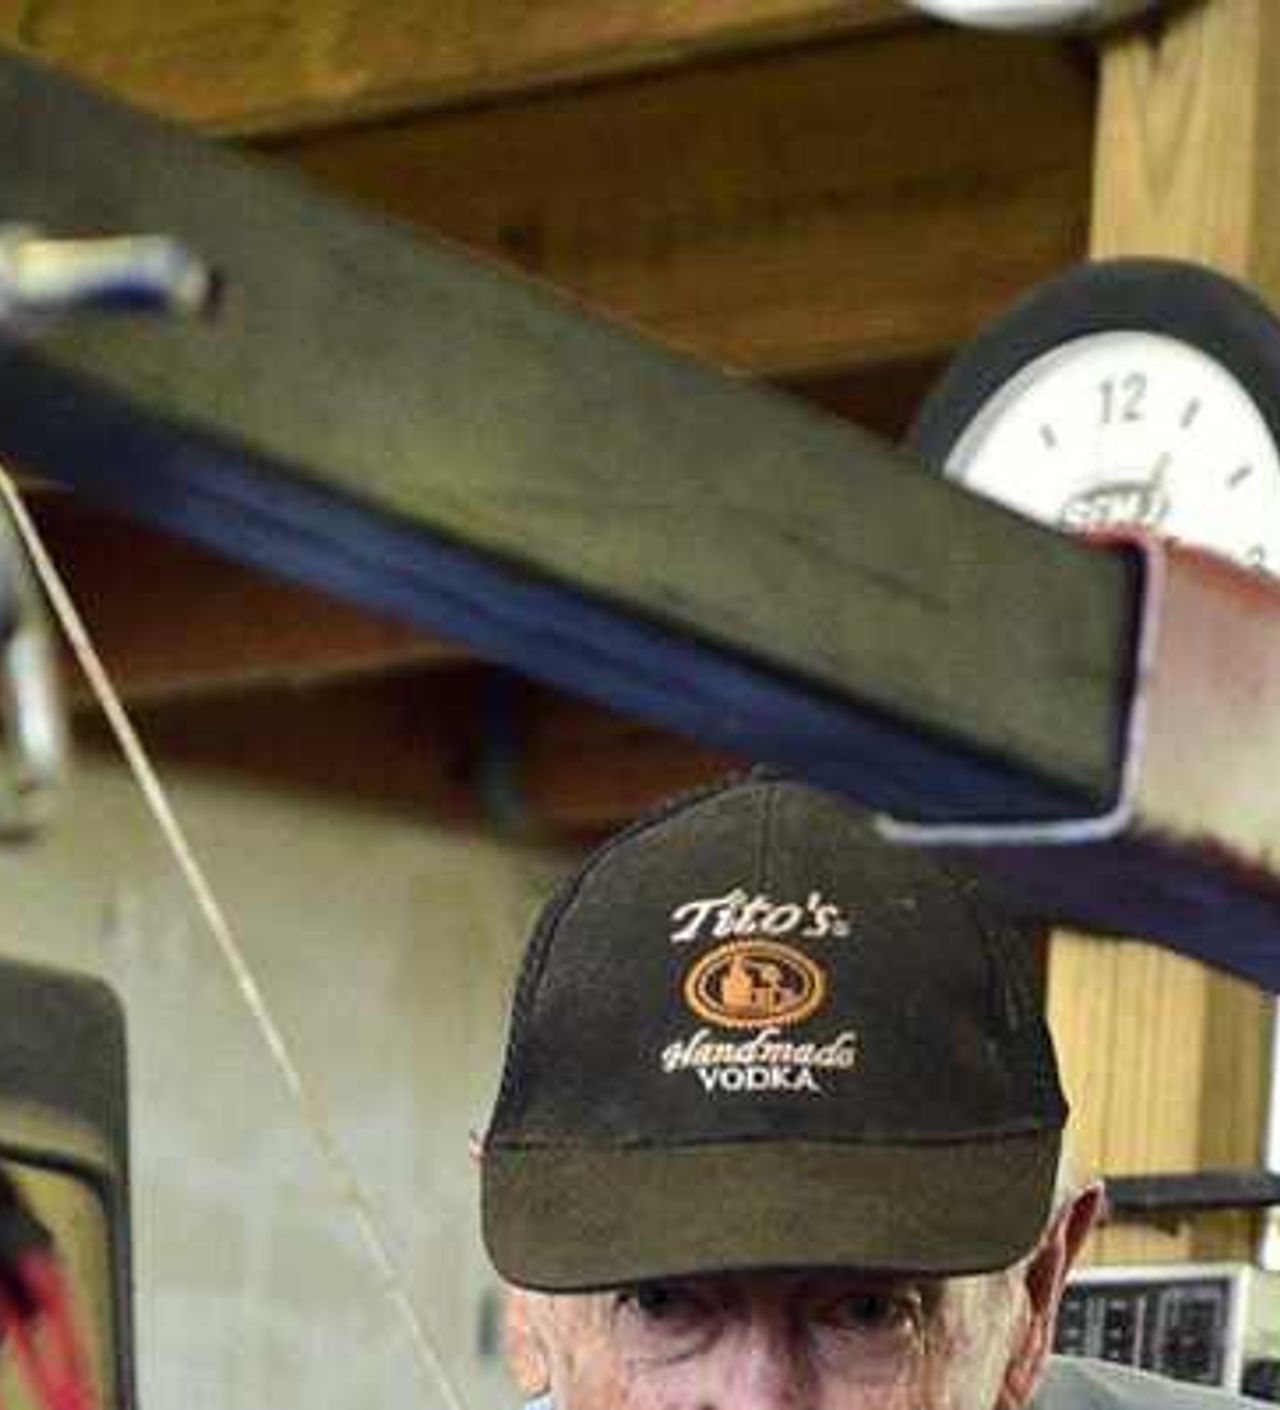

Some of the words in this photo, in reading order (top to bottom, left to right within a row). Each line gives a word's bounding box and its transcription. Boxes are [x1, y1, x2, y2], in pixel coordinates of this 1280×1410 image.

[1098, 371, 1147, 424] 12
[660, 1027, 856, 1073] Handmade
[696, 1066, 820, 1091] VODKA
